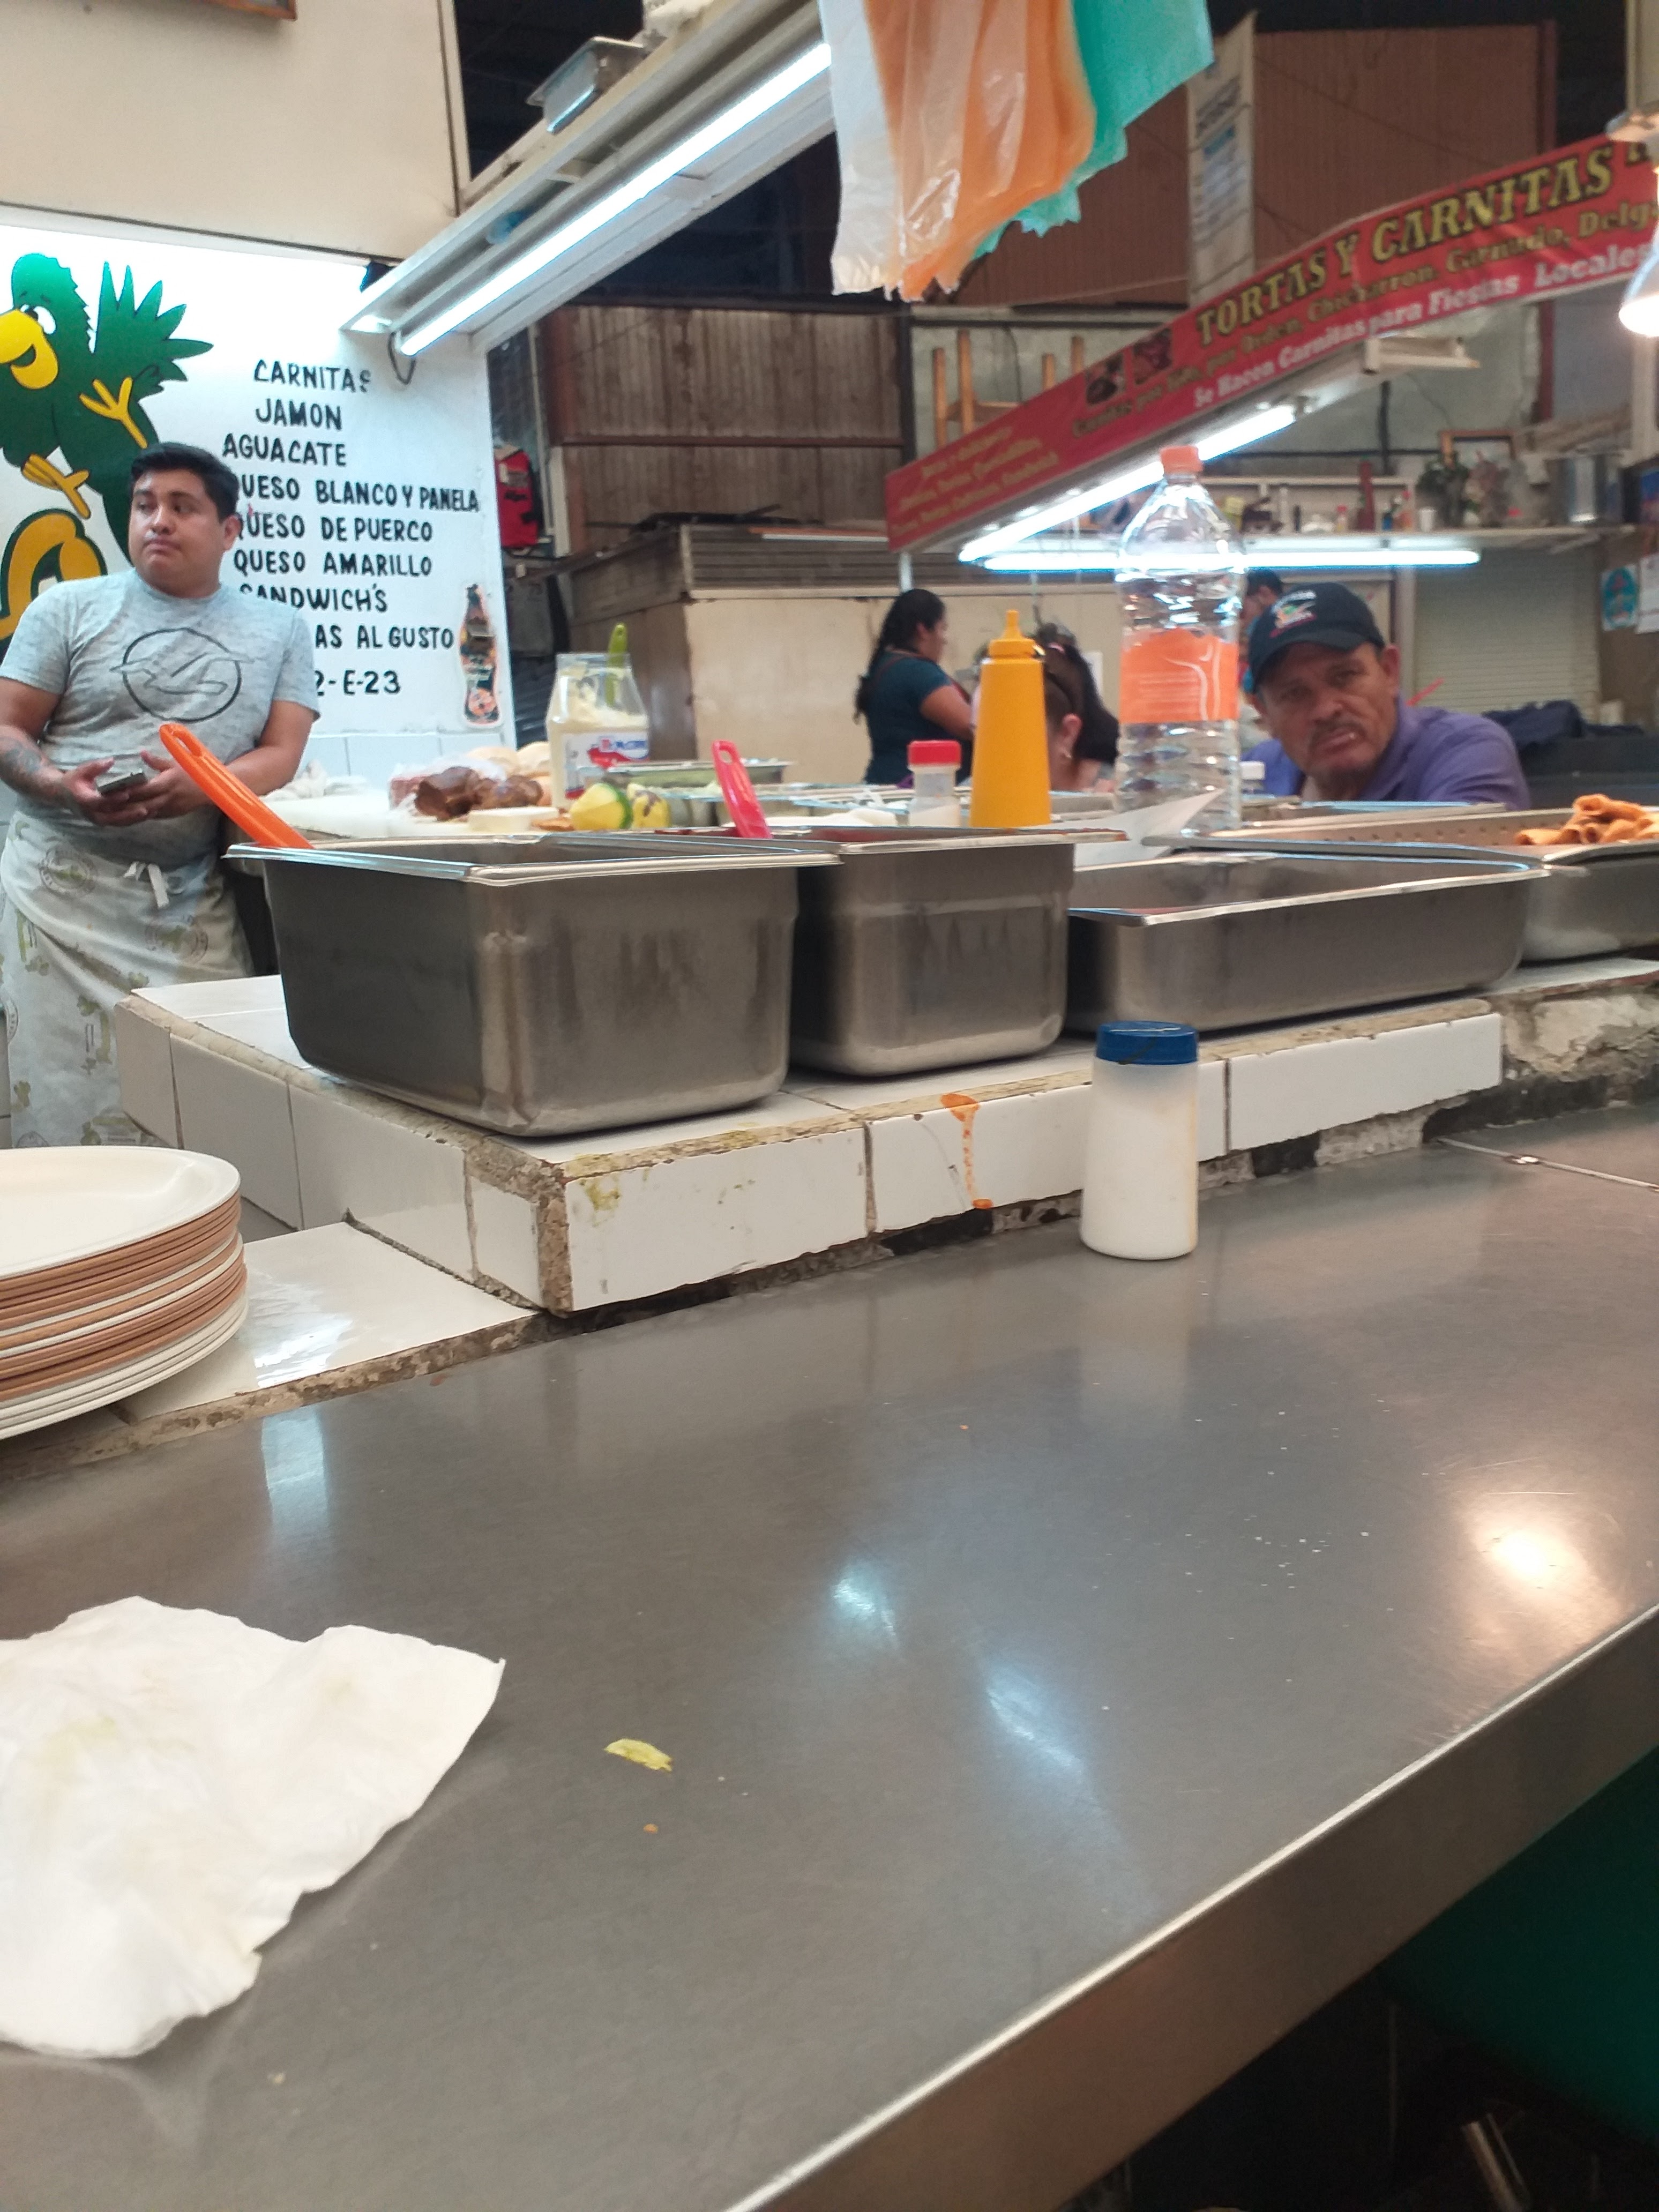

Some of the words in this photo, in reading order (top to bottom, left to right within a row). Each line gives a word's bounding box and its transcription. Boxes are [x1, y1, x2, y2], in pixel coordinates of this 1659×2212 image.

[1195, 245, 1327, 348] TORTAS
[1335, 230, 1361, 279] Y
[1371, 146, 1613, 264] CARNITAS
[253, 358, 371, 393] CARNITAS
[255, 398, 342, 430] JAMON
[222, 433, 346, 466] AGUACATE
[241, 474, 300, 500] UESO
[316, 480, 398, 506] BLANCO
[401, 485, 413, 508] Y
[420, 487, 480, 512] PANELA
[322, 517, 347, 541] DE
[355, 517, 434, 542] PUERCO
[234, 549, 305, 576] QUESO
[323, 552, 433, 577] AMARILLO
[315, 624, 342, 649] AS
[357, 624, 383, 649] AL
[388, 626, 454, 649] GUSTO
